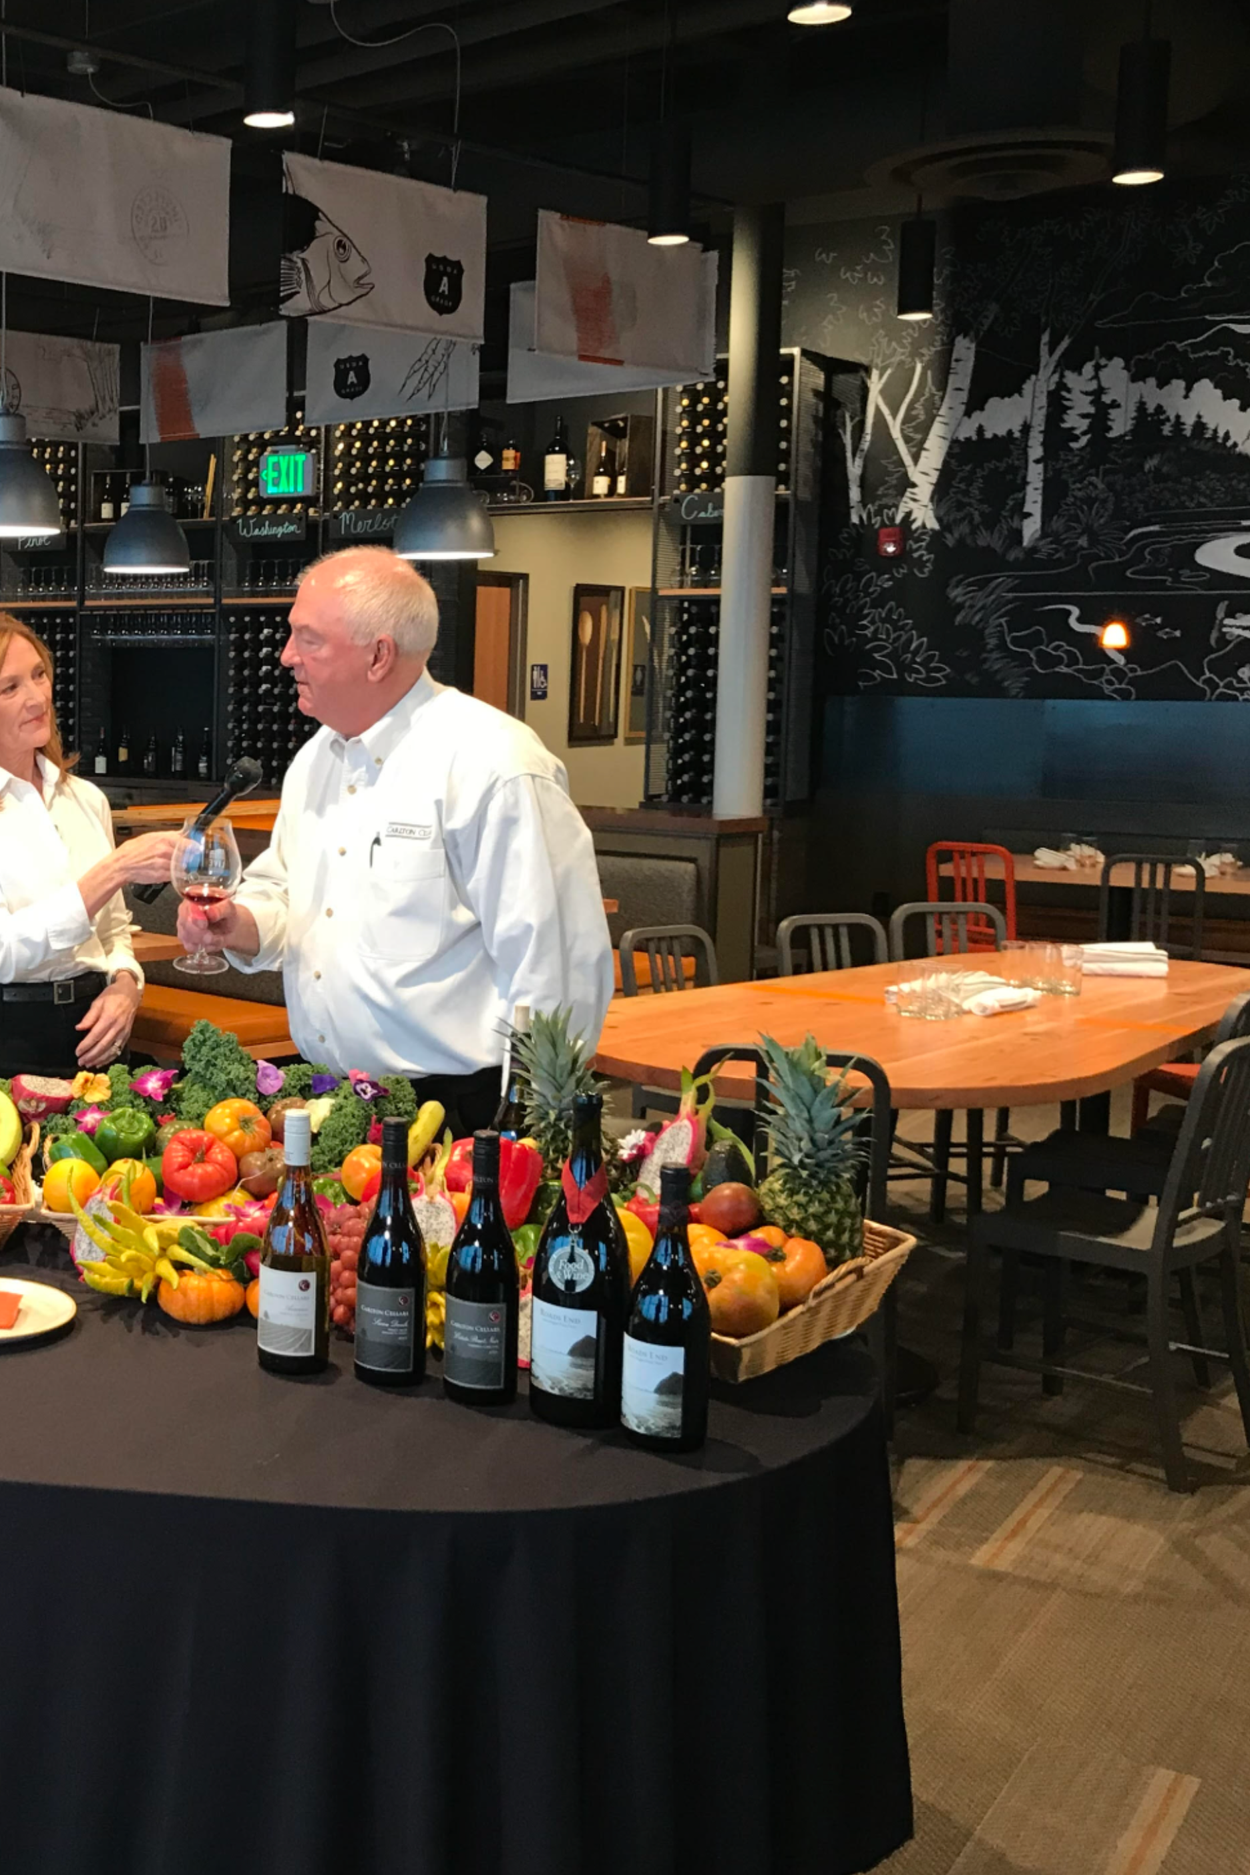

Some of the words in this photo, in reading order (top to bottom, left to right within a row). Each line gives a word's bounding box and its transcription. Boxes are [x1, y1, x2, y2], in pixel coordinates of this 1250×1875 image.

[439, 276, 449, 295] A
[347, 370, 357, 385] A
[267, 454, 306, 494] EXIT
[237, 517, 301, 539] Washington
[340, 512, 401, 535] Merlot
[559, 1259, 584, 1271] Food
